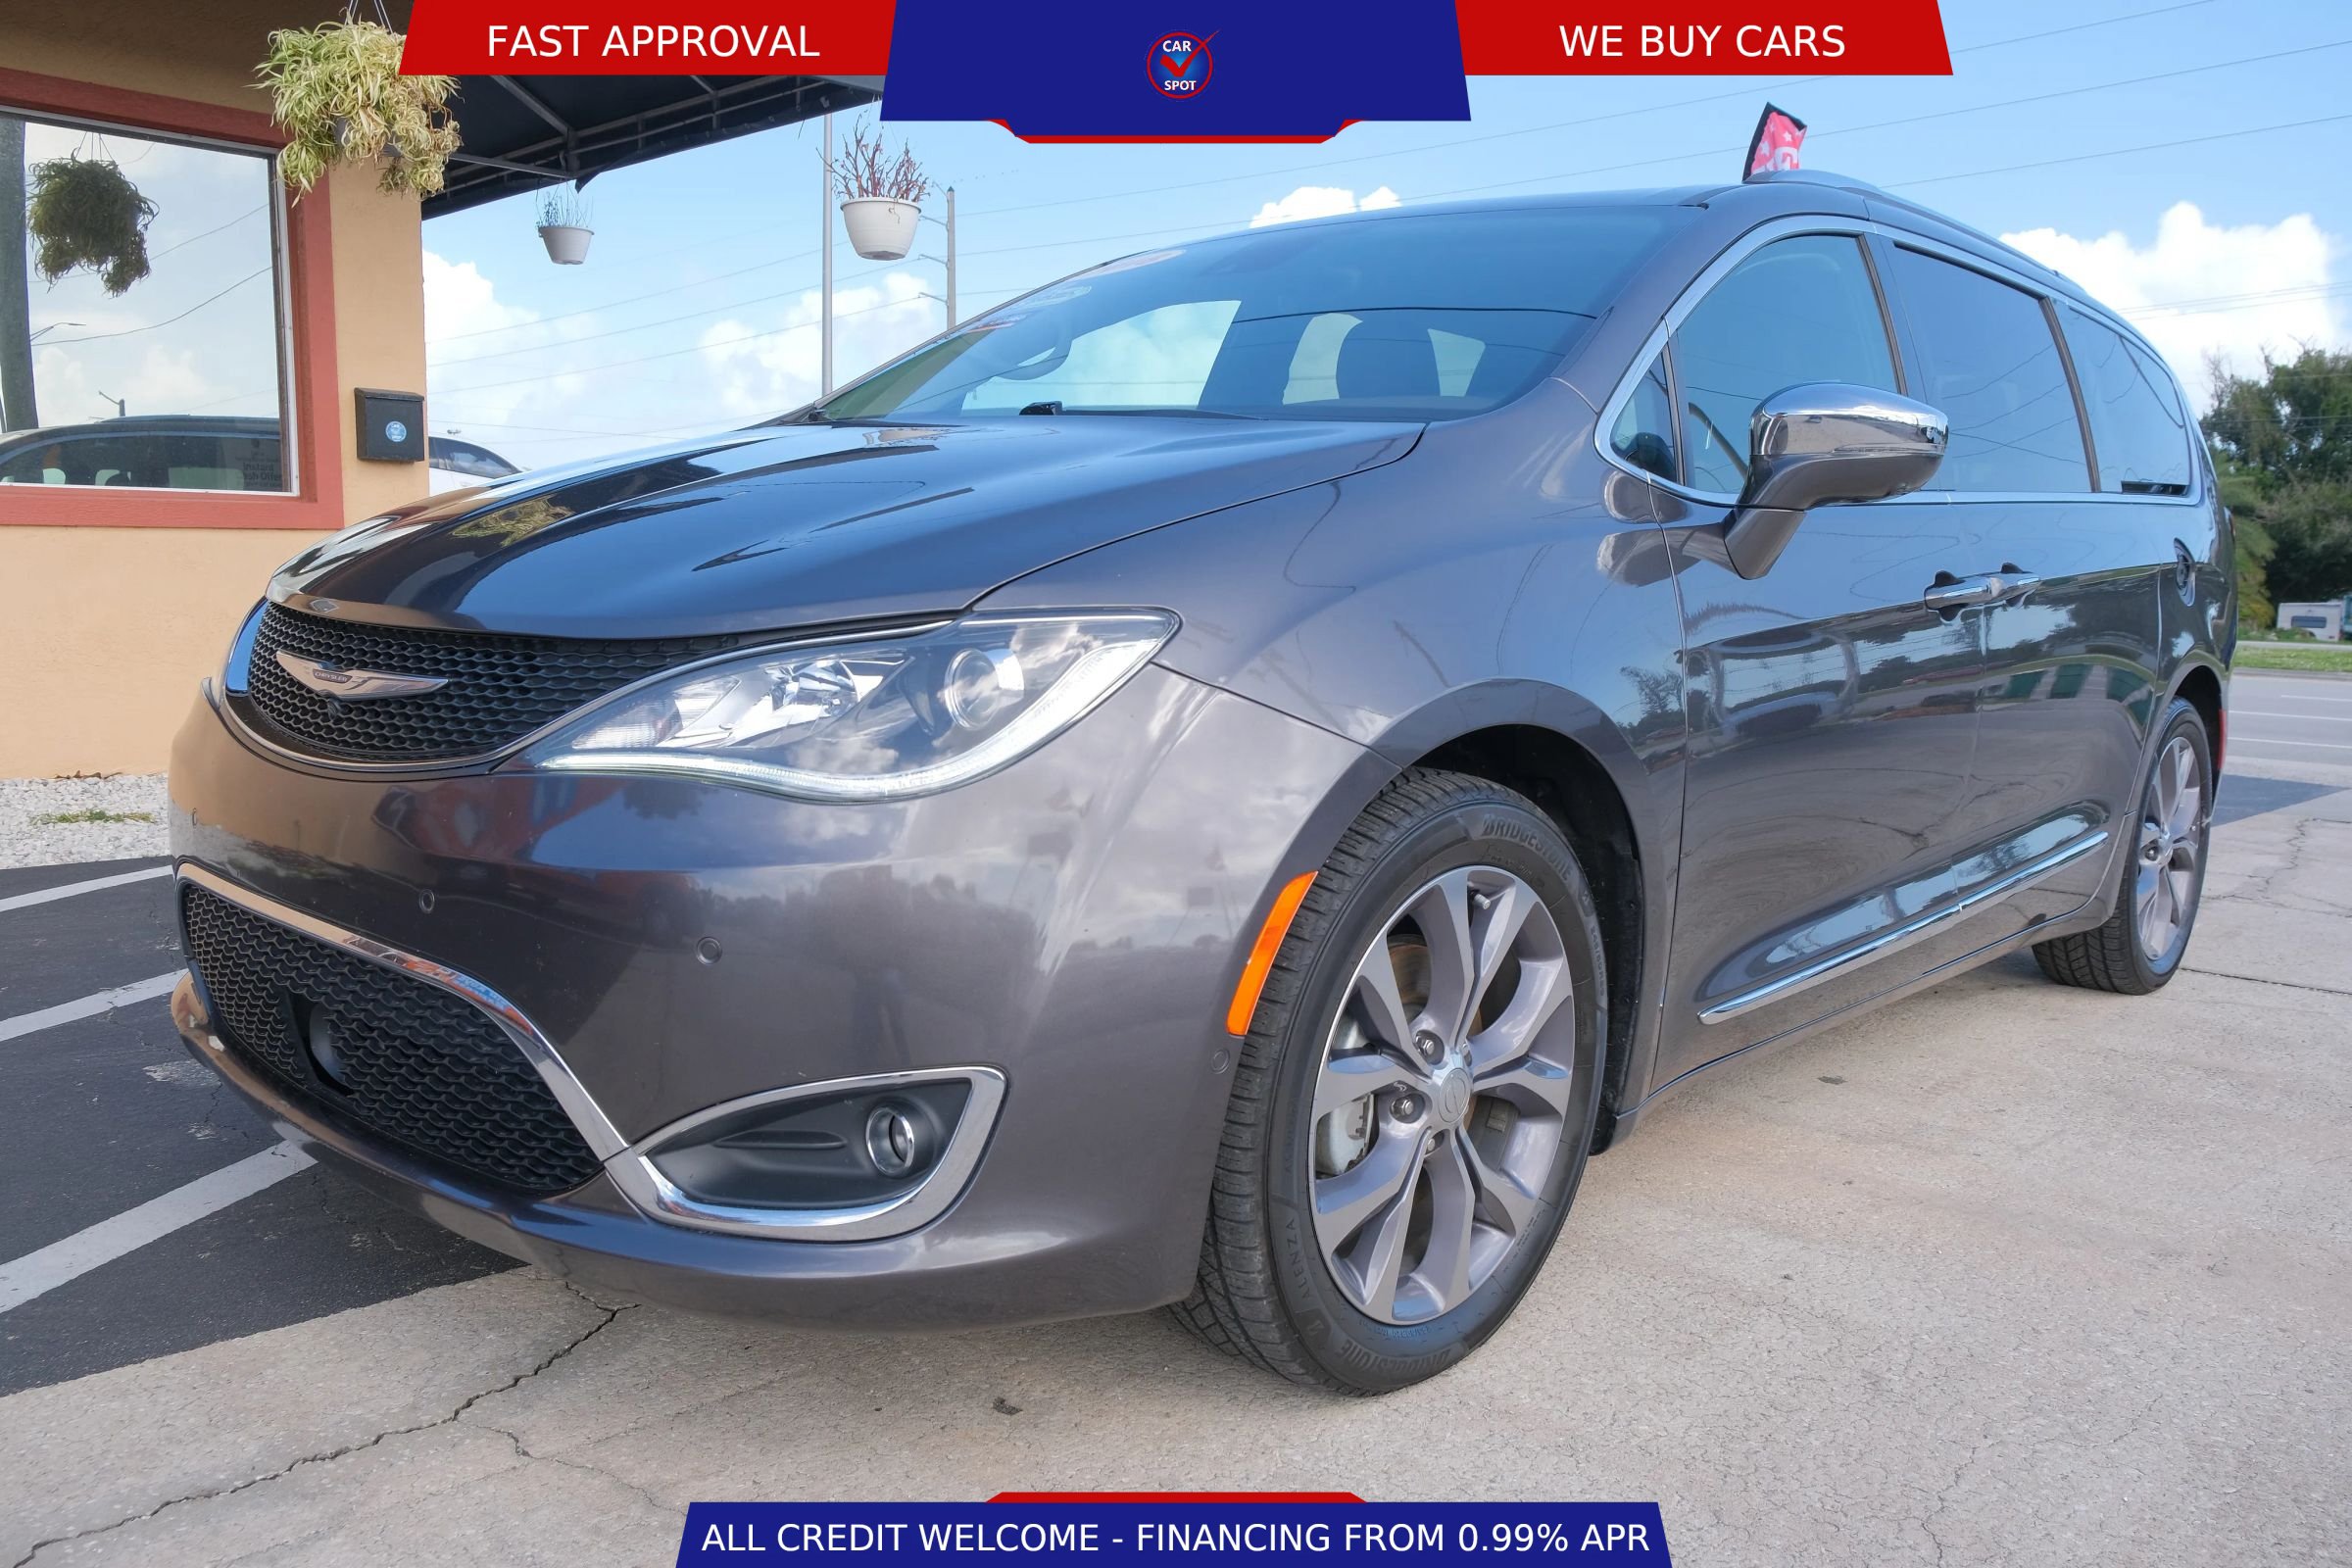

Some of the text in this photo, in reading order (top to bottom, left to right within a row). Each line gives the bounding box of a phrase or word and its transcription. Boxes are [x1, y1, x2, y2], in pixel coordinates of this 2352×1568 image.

[314, 671, 348, 683] CHRYSLER
[1481, 812, 1571, 882] BRIDGESTONE
[1285, 1218, 1311, 1300] ALENZA
